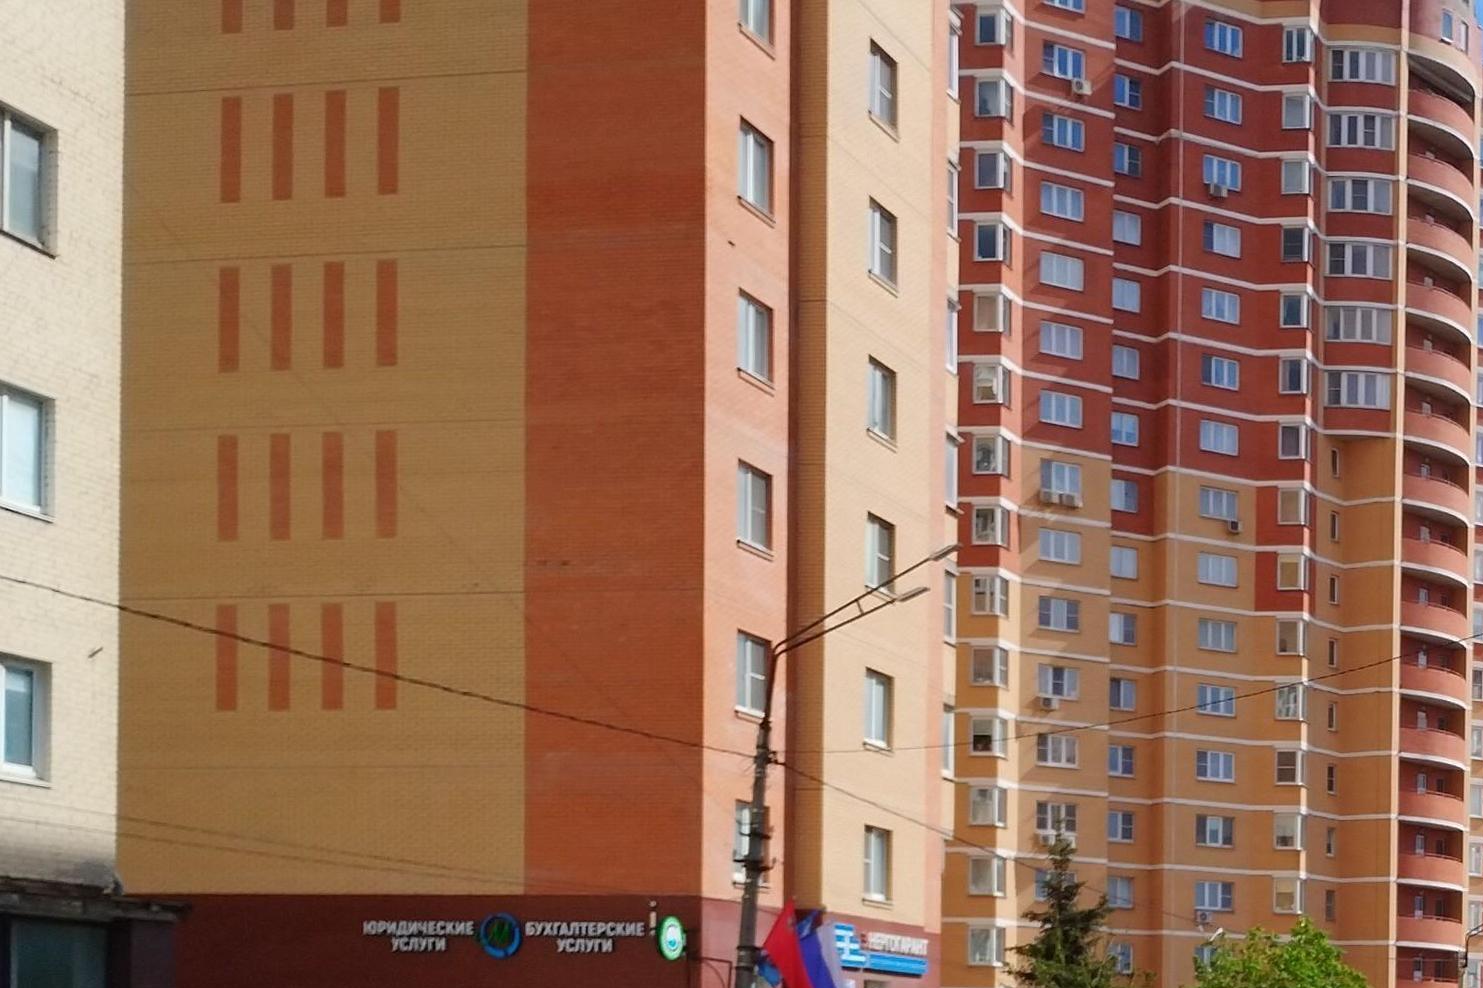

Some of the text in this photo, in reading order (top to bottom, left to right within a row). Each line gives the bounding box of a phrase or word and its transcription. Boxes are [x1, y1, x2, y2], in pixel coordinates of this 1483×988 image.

[363, 921, 474, 936] ЮРИДИЧЕСКИЕ
[525, 922, 645, 937] БУХГАЛТЕРСКИЕ
[391, 937, 446, 952] УСЛУГИ
[556, 938, 613, 953] УСЛУГИ
